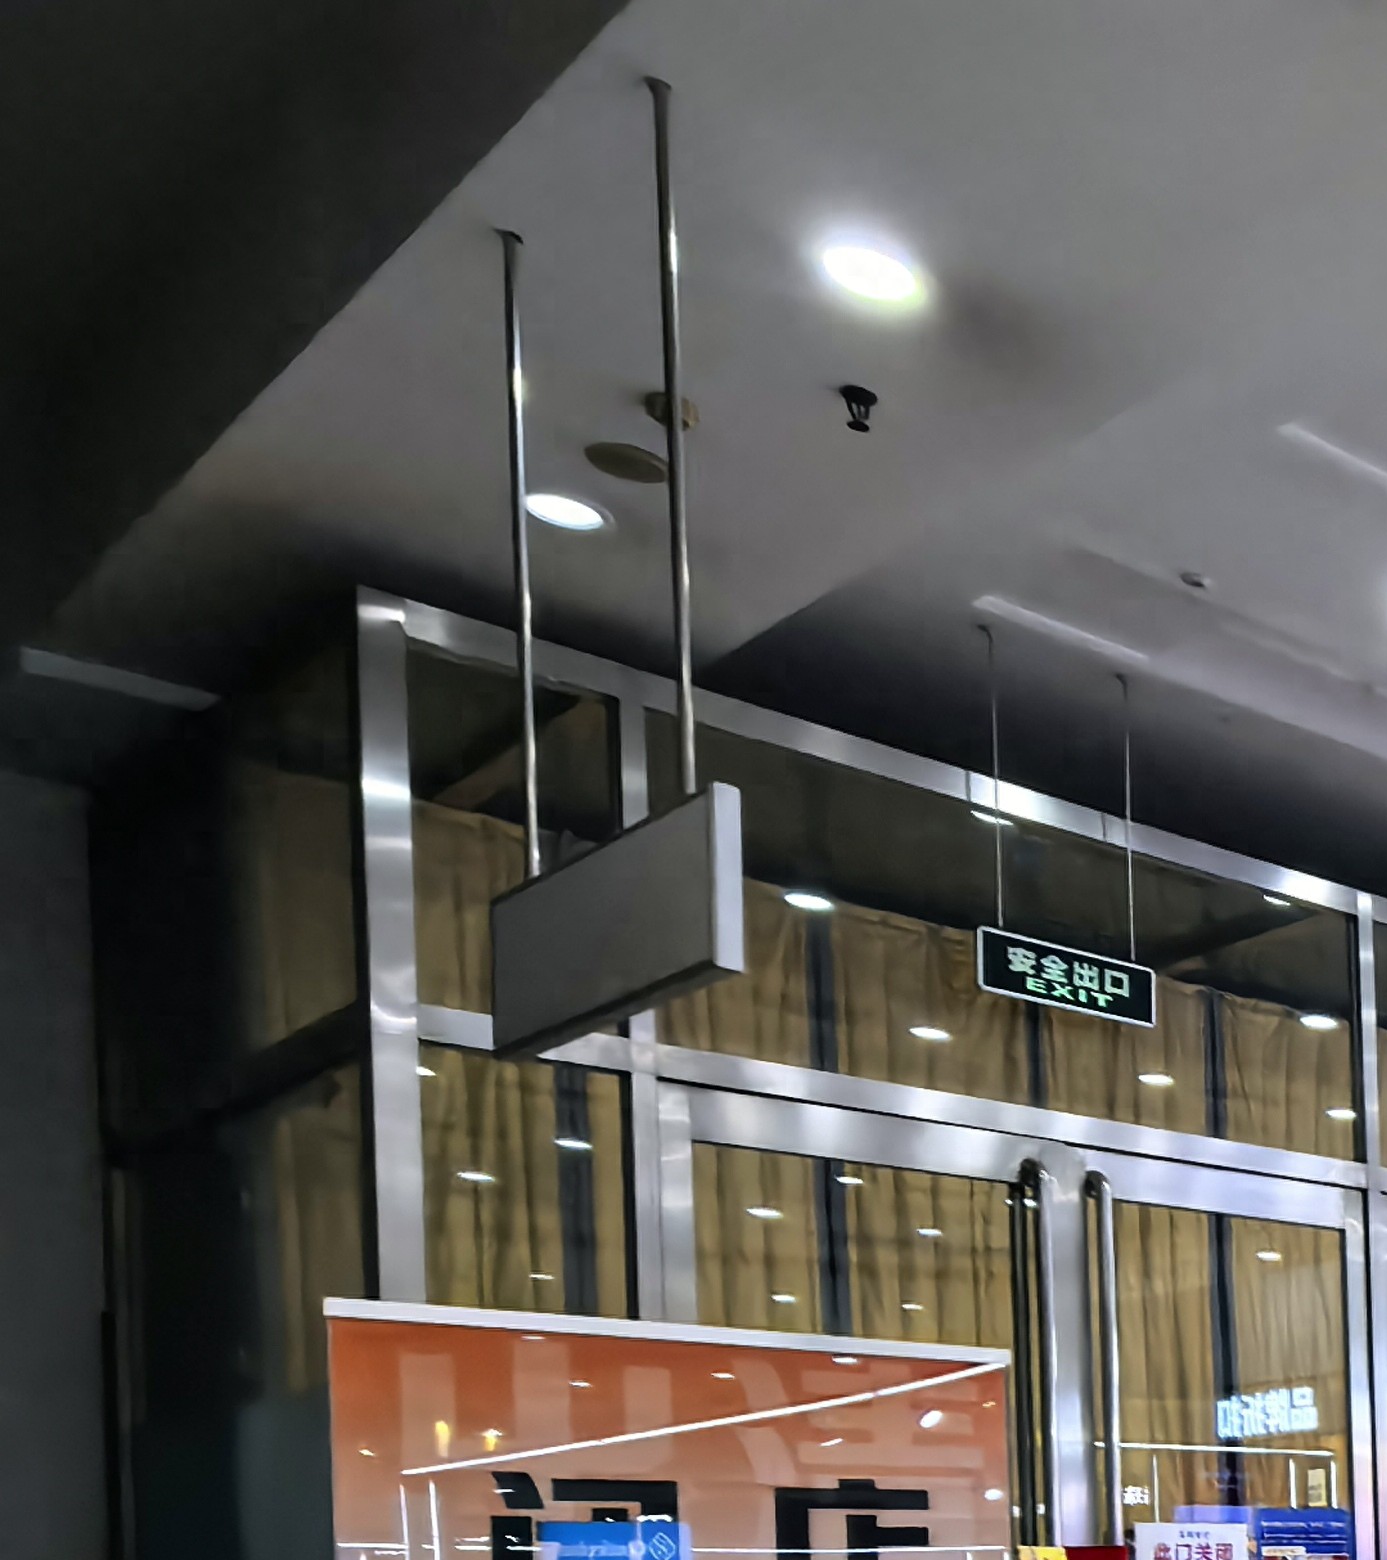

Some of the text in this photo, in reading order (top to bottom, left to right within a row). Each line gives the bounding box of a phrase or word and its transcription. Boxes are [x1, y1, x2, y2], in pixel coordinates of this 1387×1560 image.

[1006, 946, 1130, 998] 安全出口
[1025, 976, 1115, 1008] EXIT
